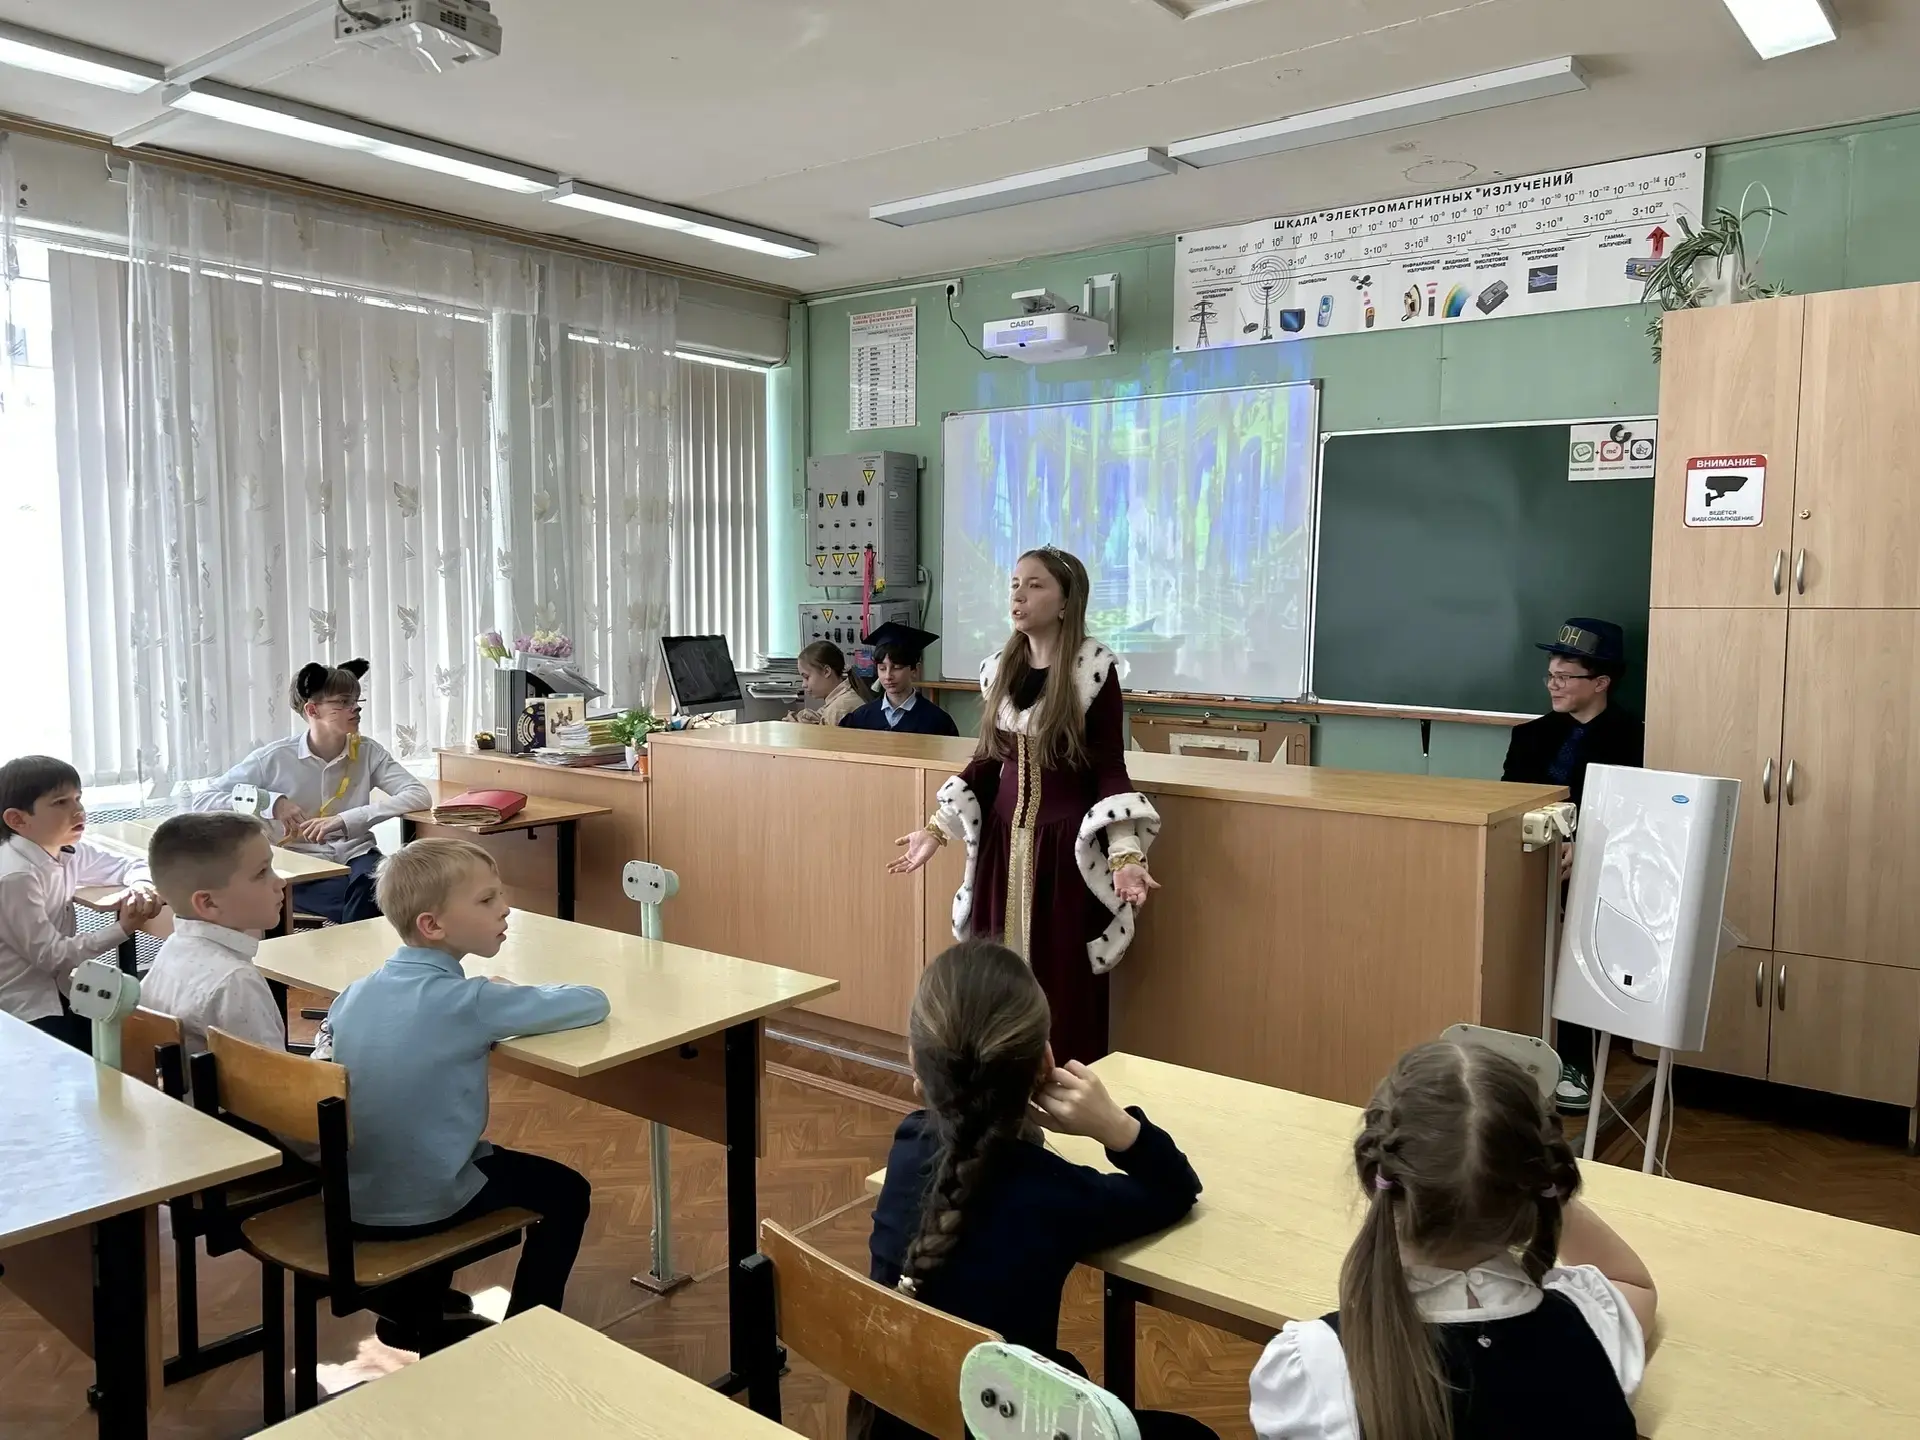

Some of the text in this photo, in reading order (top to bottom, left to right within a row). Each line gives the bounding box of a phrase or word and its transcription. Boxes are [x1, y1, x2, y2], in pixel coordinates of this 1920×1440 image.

[1274, 171, 1574, 230] ШКАЛА ЭЛЕКТРОМАГНИТНЫХ ИЗЛУЧЕНИЙ
[1010, 319, 1034, 329] CASIO
[1696, 457, 1757, 469] ВНИМАНИЕ
